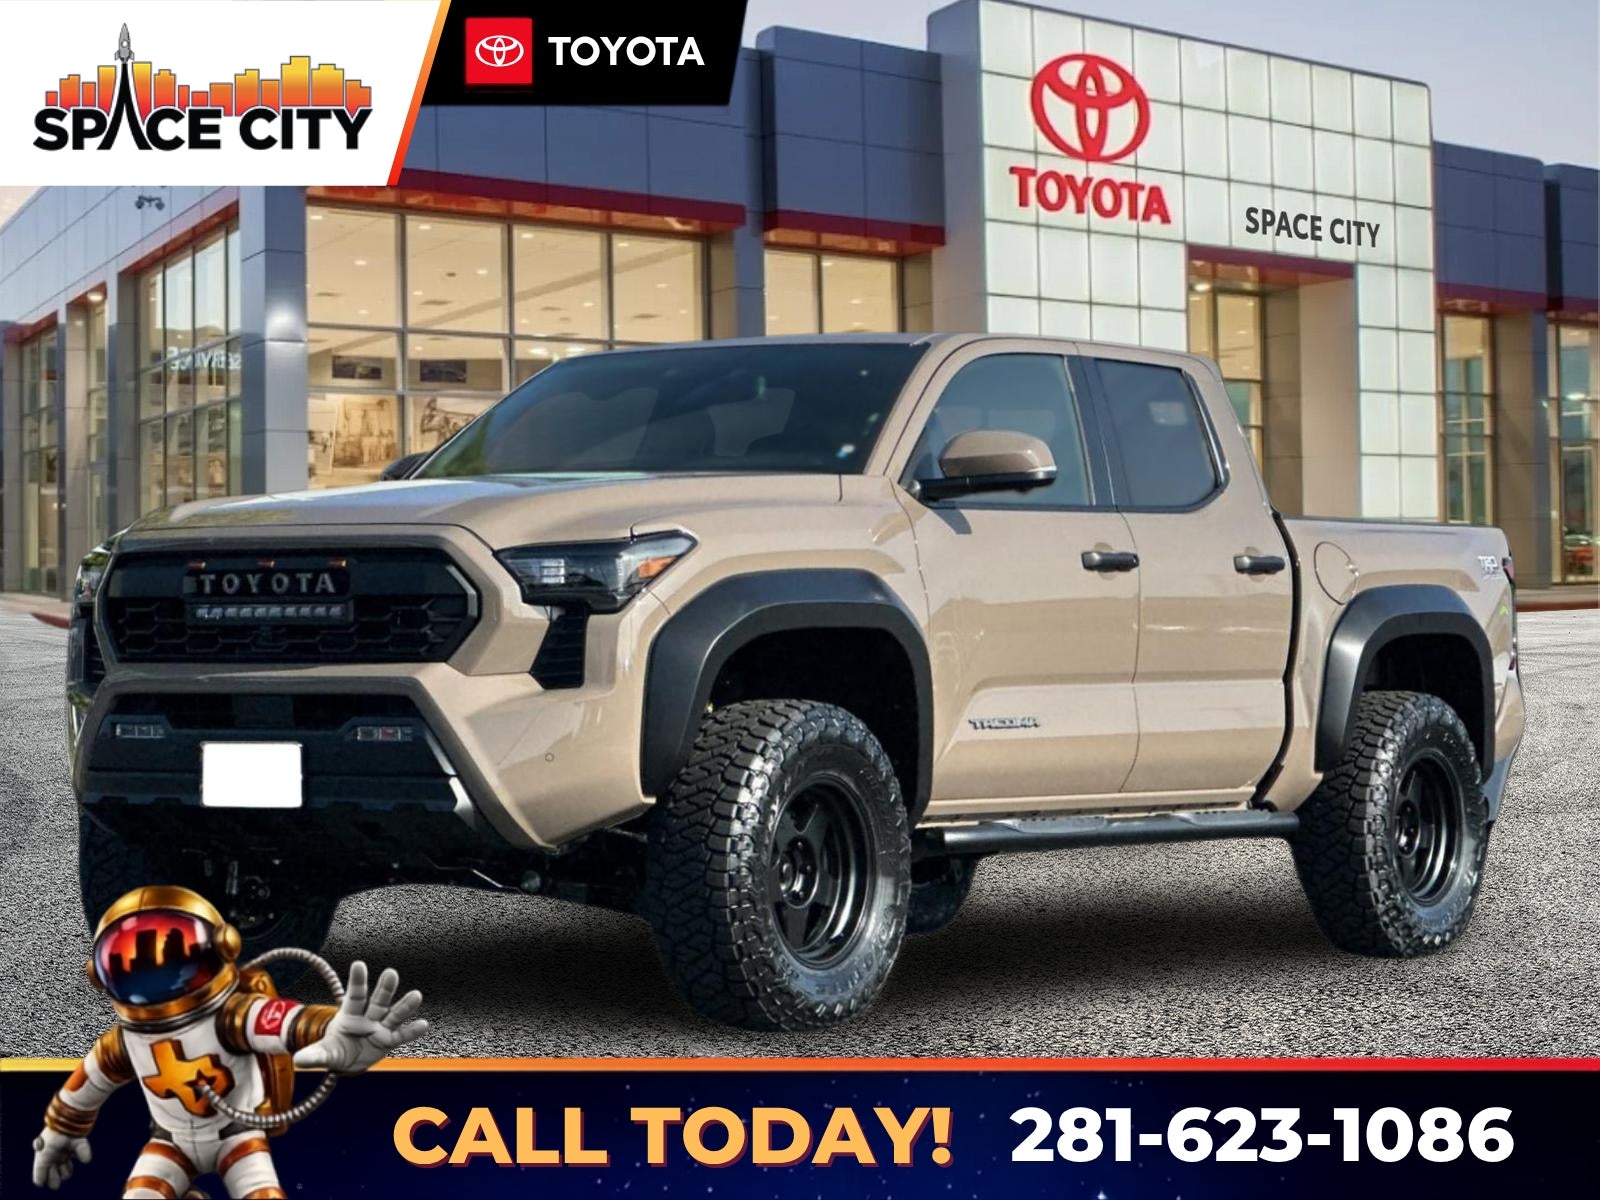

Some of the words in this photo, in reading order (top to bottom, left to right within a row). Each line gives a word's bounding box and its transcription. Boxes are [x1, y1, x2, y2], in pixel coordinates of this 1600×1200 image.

[1009, 166, 1171, 224] TOYOTA
[1245, 206, 1322, 242] SPACE
[1330, 218, 1381, 248] CITY
[200, 573, 336, 595] TOYOTA
